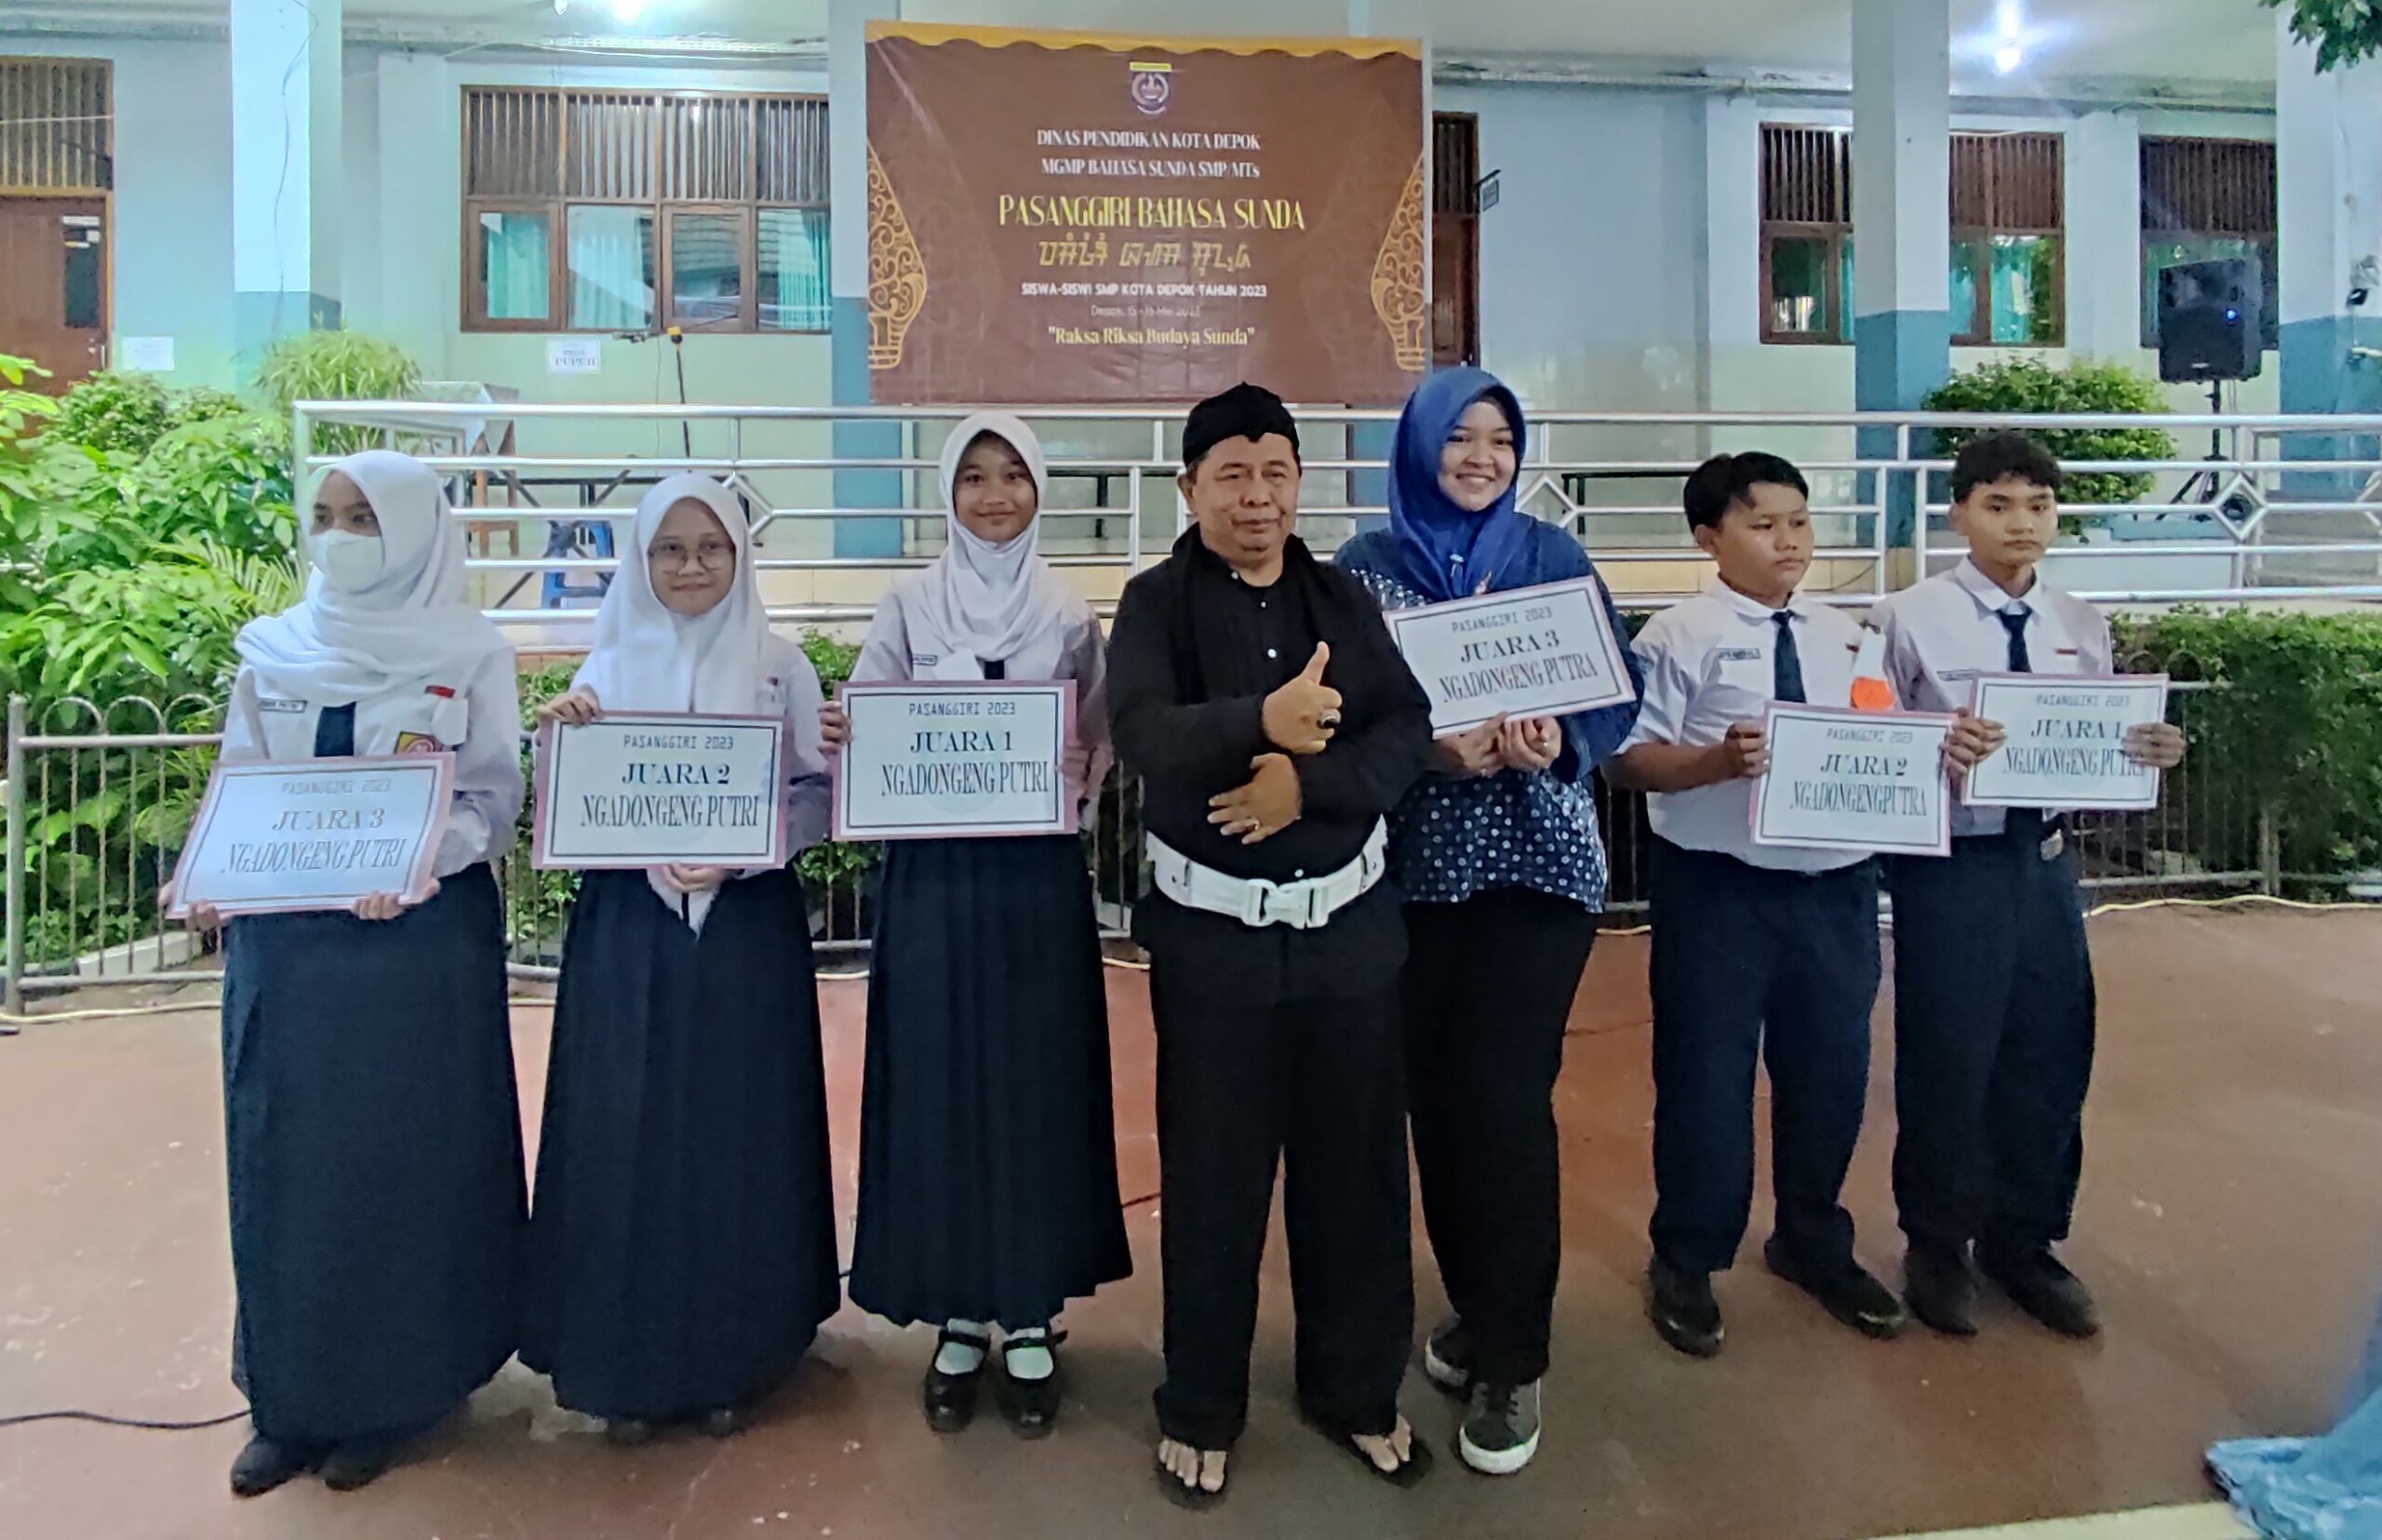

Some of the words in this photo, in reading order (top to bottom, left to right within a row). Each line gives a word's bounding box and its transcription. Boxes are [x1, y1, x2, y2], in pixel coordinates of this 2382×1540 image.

[1037, 129, 1080, 146] DINAS
[1082, 130, 1169, 148] PENDIDIKAN
[1171, 132, 1211, 148] KOTA
[1213, 133, 1261, 150] DEPOK
[1042, 158, 1086, 175] MGMP
[1088, 159, 1145, 176] BAHASA
[1148, 161, 1196, 177] SUNDA
[999, 194, 1131, 227] PASANGGIRI
[1138, 197, 1226, 229] BAHASA
[1234, 198, 1305, 231] SUNDA
[1022, 282, 1091, 296] SISWA-SISWI
[1094, 283, 1117, 296] SMP
[1121, 283, 1154, 296] KOTA
[1157, 283, 1195, 296] DEPOK
[1198, 283, 1238, 297] TAHUN
[1240, 284, 1267, 297] 2023
[1104, 327, 1143, 344] Riksa
[1145, 328, 1199, 349] Budaya
[1451, 610, 1519, 634] PASANGGIRI
[1525, 607, 1553, 623] 2023
[1461, 636, 1540, 663] JUARA
[1545, 630, 1560, 649] 3
[1439, 661, 1545, 703] NGADONGENG
[1543, 653, 1599, 685] PUTRA
[909, 702, 980, 716] PASANGGIRI
[987, 702, 1016, 716] 2023
[2030, 719, 2105, 739] JUARA
[2111, 721, 2121, 738] 1
[623, 735, 697, 749] PASANGGIRI
[705, 736, 733, 750] 2023
[910, 730, 997, 752] JUARA
[1004, 731, 1012, 750] 1
[1820, 754, 1890, 775] JUARA
[1896, 758, 1907, 776] 2
[2003, 747, 2098, 775] NGADONGENG
[622, 763, 710, 784] JUARA
[718, 765, 730, 784] 2
[882, 762, 995, 796] NGADONGENG
[999, 761, 1049, 793] PUTRI
[1790, 781, 1882, 812] NGADONGENG
[1882, 786, 1927, 816] PUTRA
[272, 808, 361, 831] JUARA
[369, 808, 385, 829] 3
[581, 795, 703, 827] NGADONGENG
[707, 796, 759, 827] PUTRI
[221, 839, 348, 873] NGADONGENG
[348, 837, 407, 870] PUTRI
